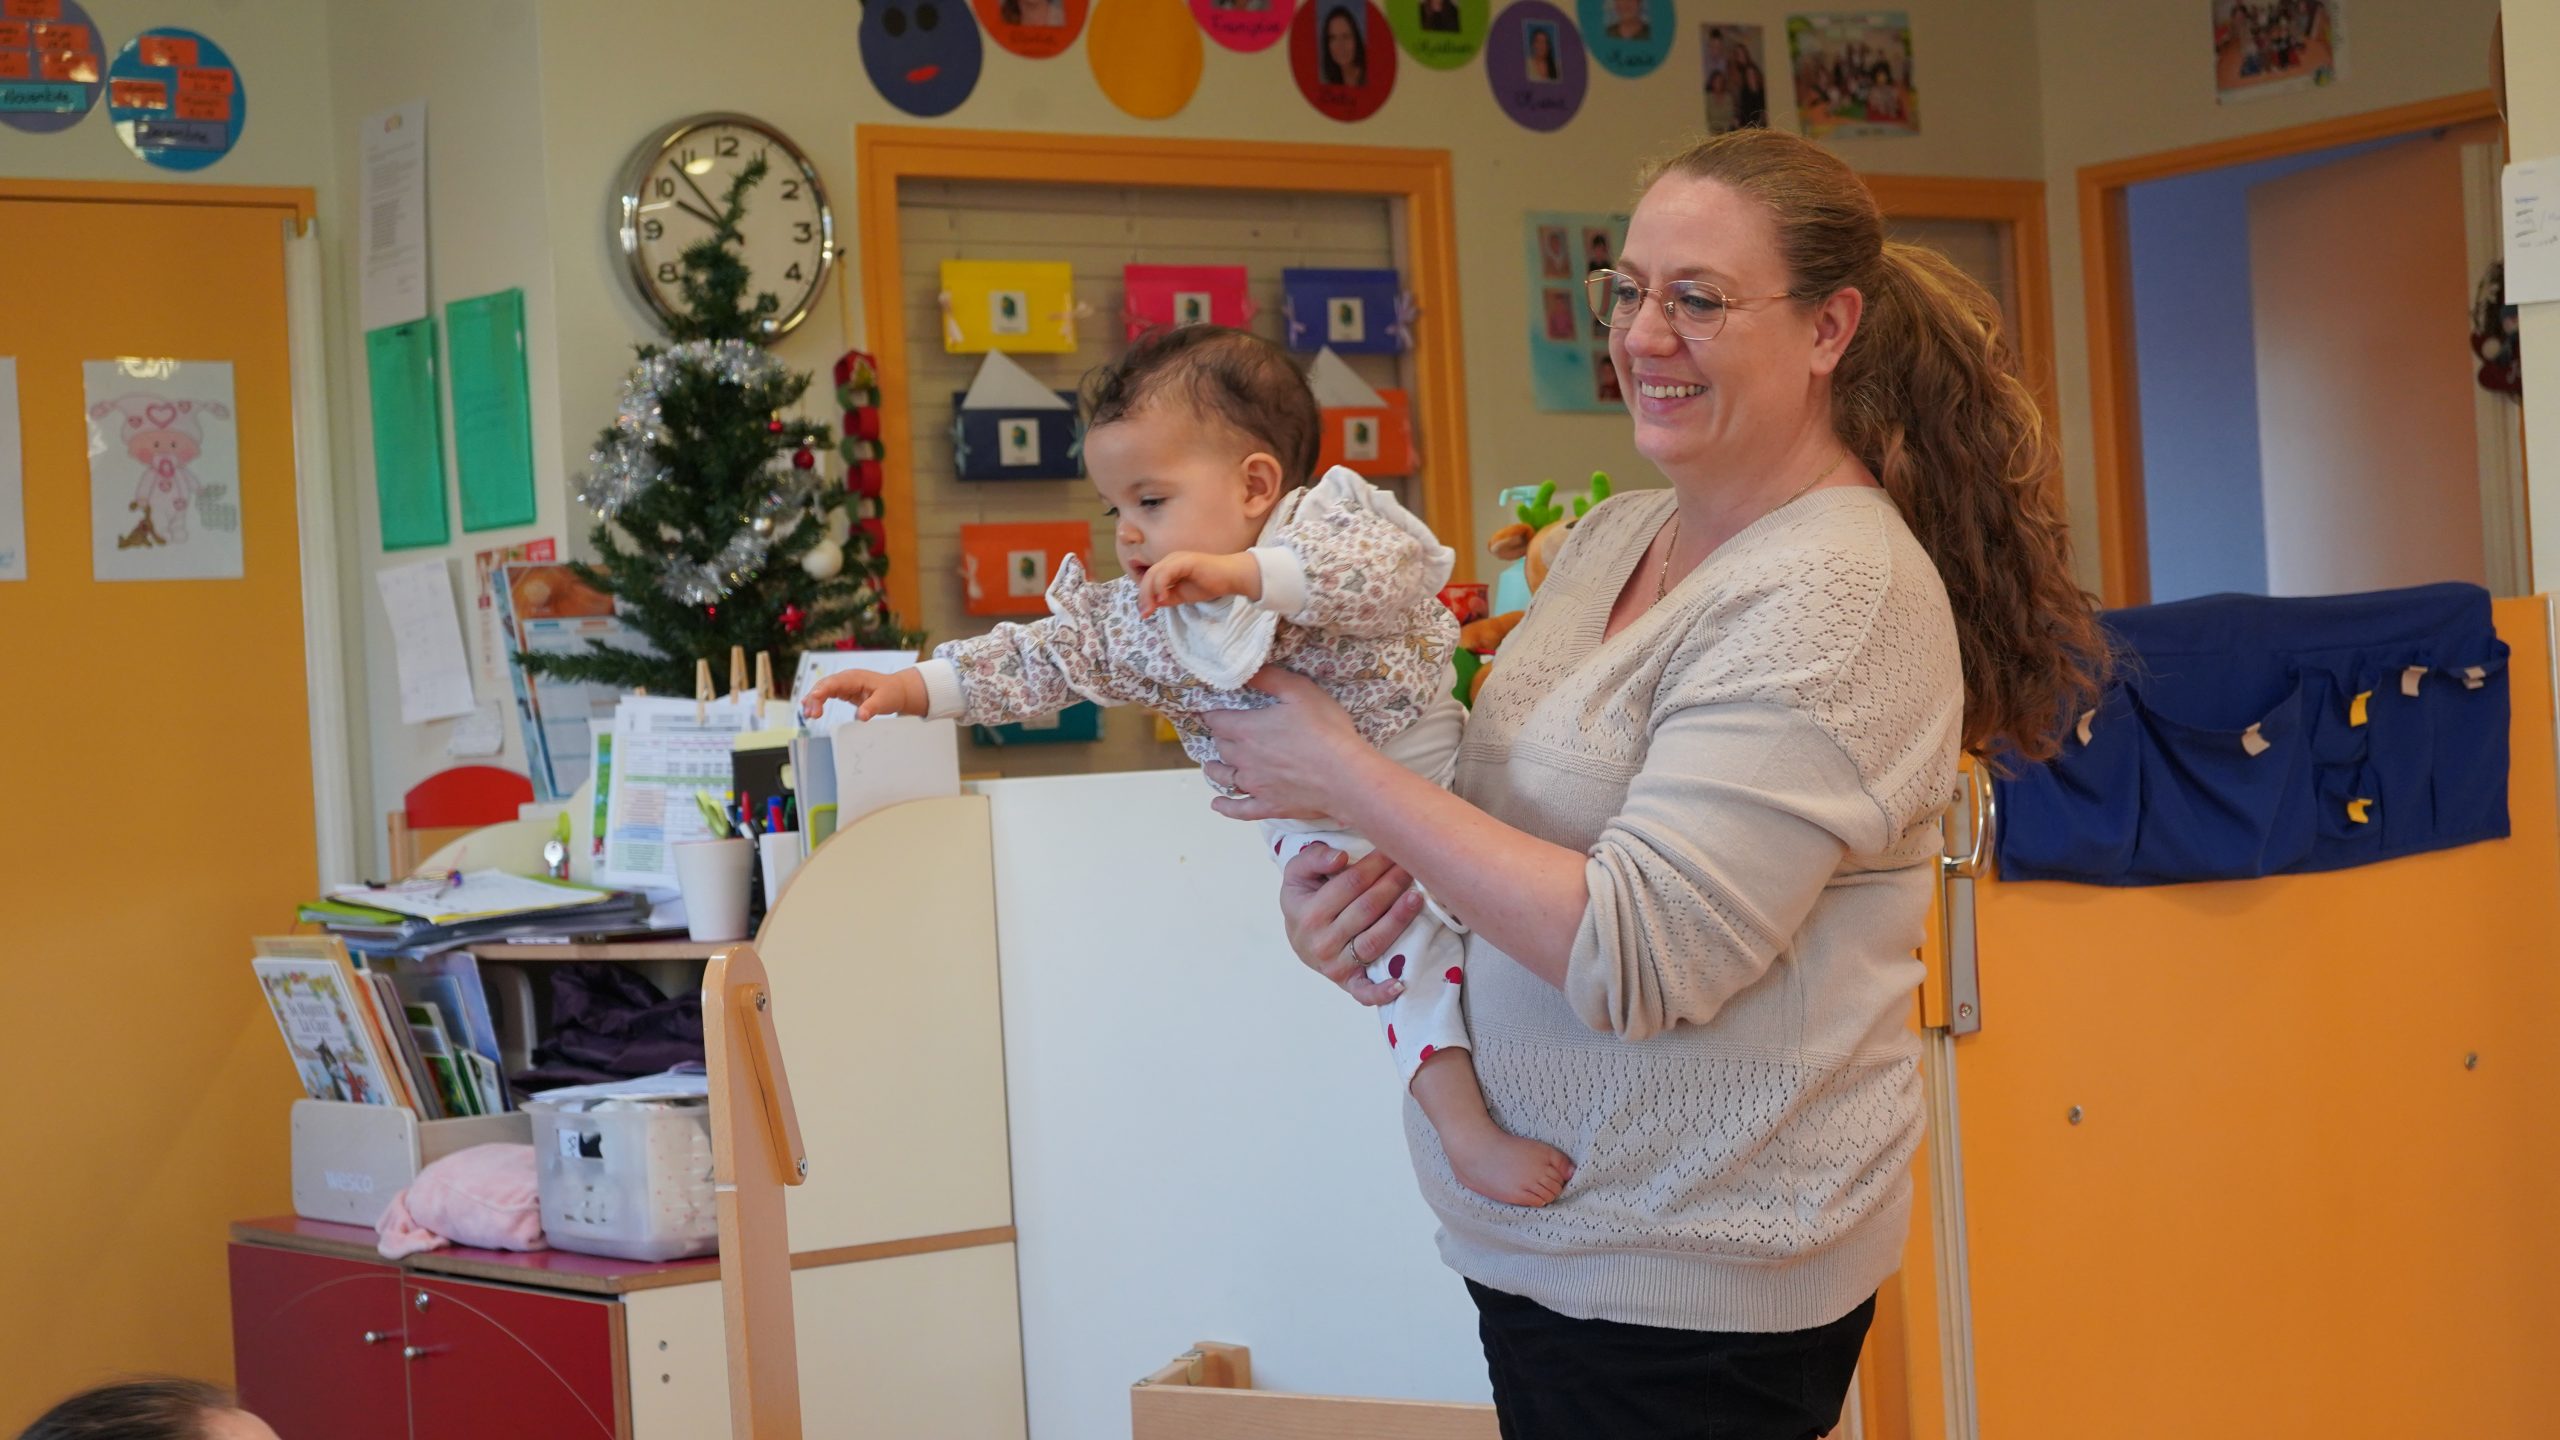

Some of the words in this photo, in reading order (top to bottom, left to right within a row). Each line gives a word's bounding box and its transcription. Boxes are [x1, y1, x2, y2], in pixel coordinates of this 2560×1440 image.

[714, 136, 740, 158] 12
[655, 177, 676, 199] 10
[781, 179, 800, 201] 2
[644, 219, 664, 242] 9
[793, 222, 813, 244] 3
[657, 262, 679, 284] 8
[785, 263, 802, 282] 4
